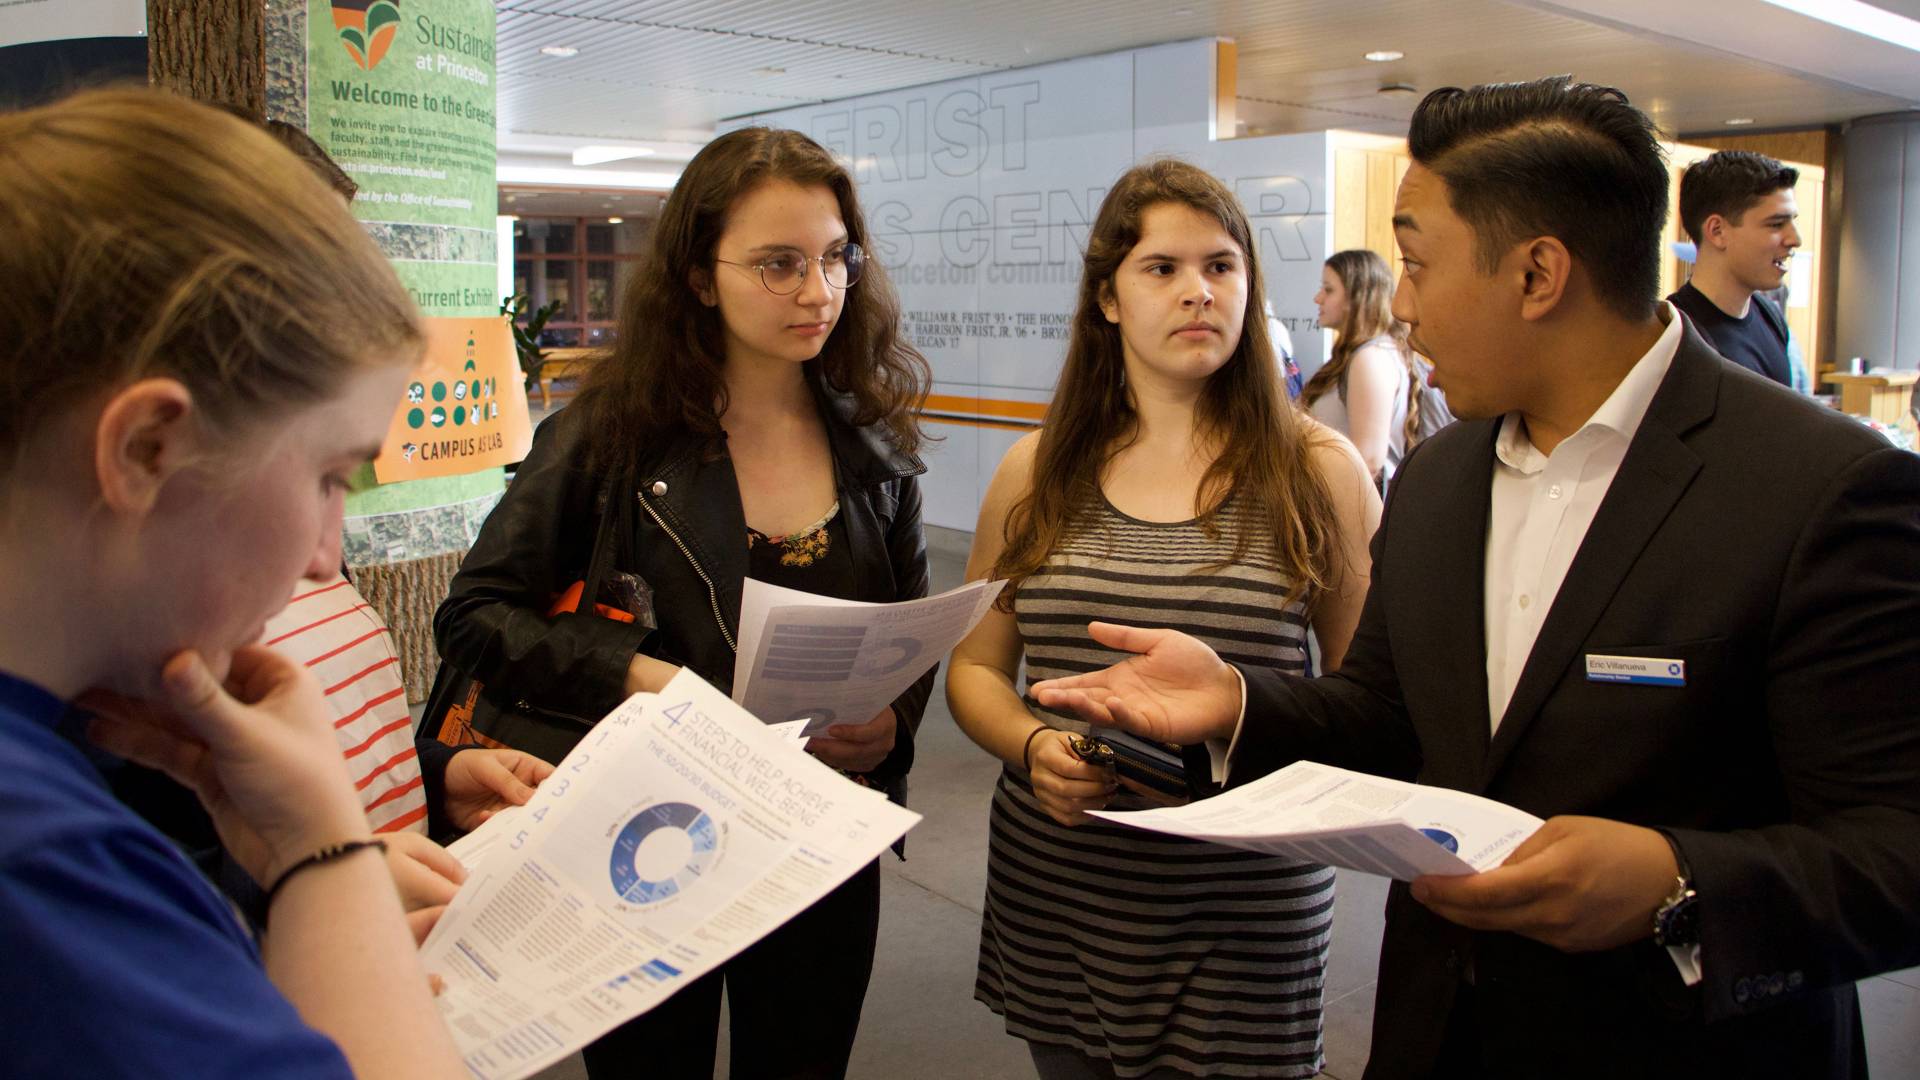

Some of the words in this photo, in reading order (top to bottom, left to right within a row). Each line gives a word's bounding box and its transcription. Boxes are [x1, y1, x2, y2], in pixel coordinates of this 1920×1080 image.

[416, 54, 433, 72] at
[437, 54, 489, 86] Princeton
[331, 80, 418, 109] Welcome
[423, 93, 438, 112] to
[442, 96, 462, 117] the
[330, 118, 348, 129] We
[350, 118, 377, 131] invite
[379, 122, 395, 134] you
[397, 124, 406, 134] to
[408, 127, 437, 139] explore
[811, 80, 1040, 185] FRIST
[395, 138, 411, 148] and
[412, 140, 425, 150] the
[331, 146, 399, 162] sustainability.
[400, 151, 418, 162] Find
[371, 191, 383, 204] by
[384, 191, 400, 202] the
[908, 311, 948, 322] WILLIAM
[962, 312, 990, 325] FRIST
[1016, 312, 1037, 325] THE
[915, 323, 962, 336] HARRISON
[966, 325, 996, 339] FRIST,
[917, 336, 946, 348] ELCAN
[420, 437, 475, 461] CAMPUS
[478, 435, 486, 454] AS
[487, 432, 503, 451] LAB
[1589, 660, 1606, 669] Eric
[1606, 661, 1647, 671] Villanueva
[596, 731, 609, 747] 1
[571, 754, 590, 773] 2
[662, 701, 693, 729] 4
[689, 711, 731, 745] STEPS
[729, 736, 751, 760] TO
[749, 752, 784, 784] HELP
[781, 777, 835, 815] ACHIEVE
[648, 740, 666, 759] THE
[699, 784, 736, 811] BUDGET
[680, 725, 747, 778] FINANCIAL
[744, 774, 818, 828] WELL-BEING
[551, 778, 570, 798] 3
[532, 806, 549, 824] 4
[510, 830, 529, 850] 5
